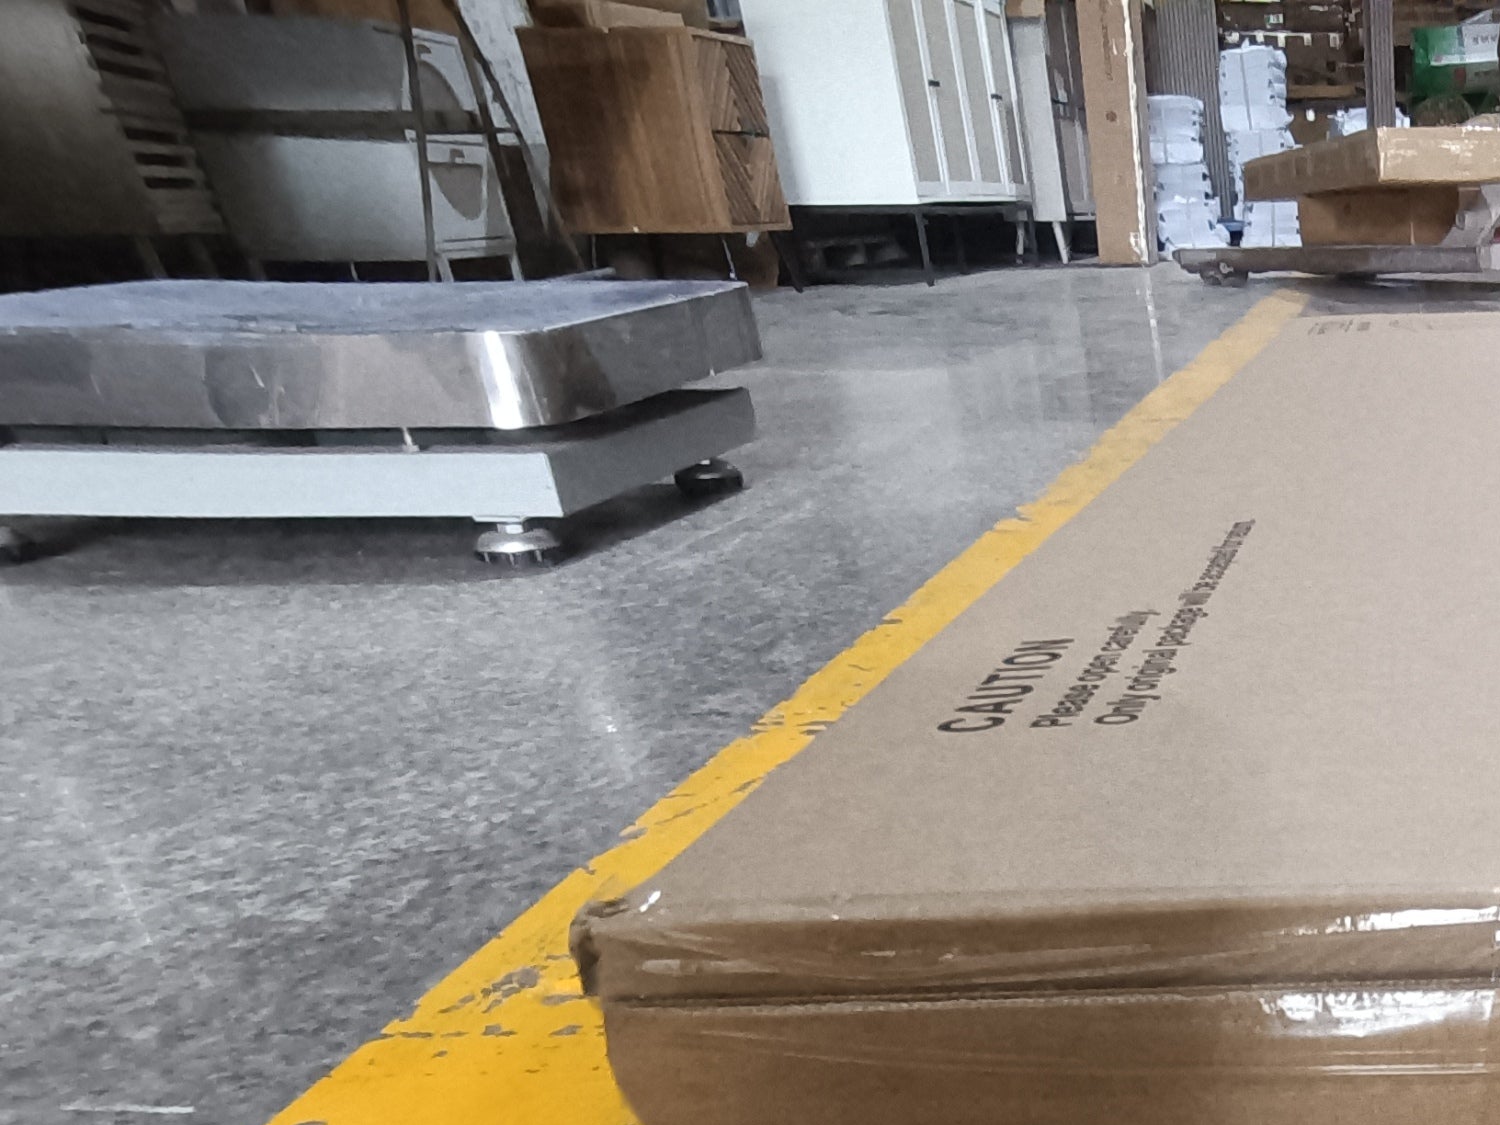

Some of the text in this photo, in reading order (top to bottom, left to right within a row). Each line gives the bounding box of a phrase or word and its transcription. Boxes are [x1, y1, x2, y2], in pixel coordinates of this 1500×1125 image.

[1155, 607, 1209, 647] package
[937, 638, 1075, 732] CAUTION
[1029, 684, 1101, 728] Please
[1076, 653, 1122, 681] open
[1125, 649, 1178, 692] original
[1094, 694, 1161, 725] Only
